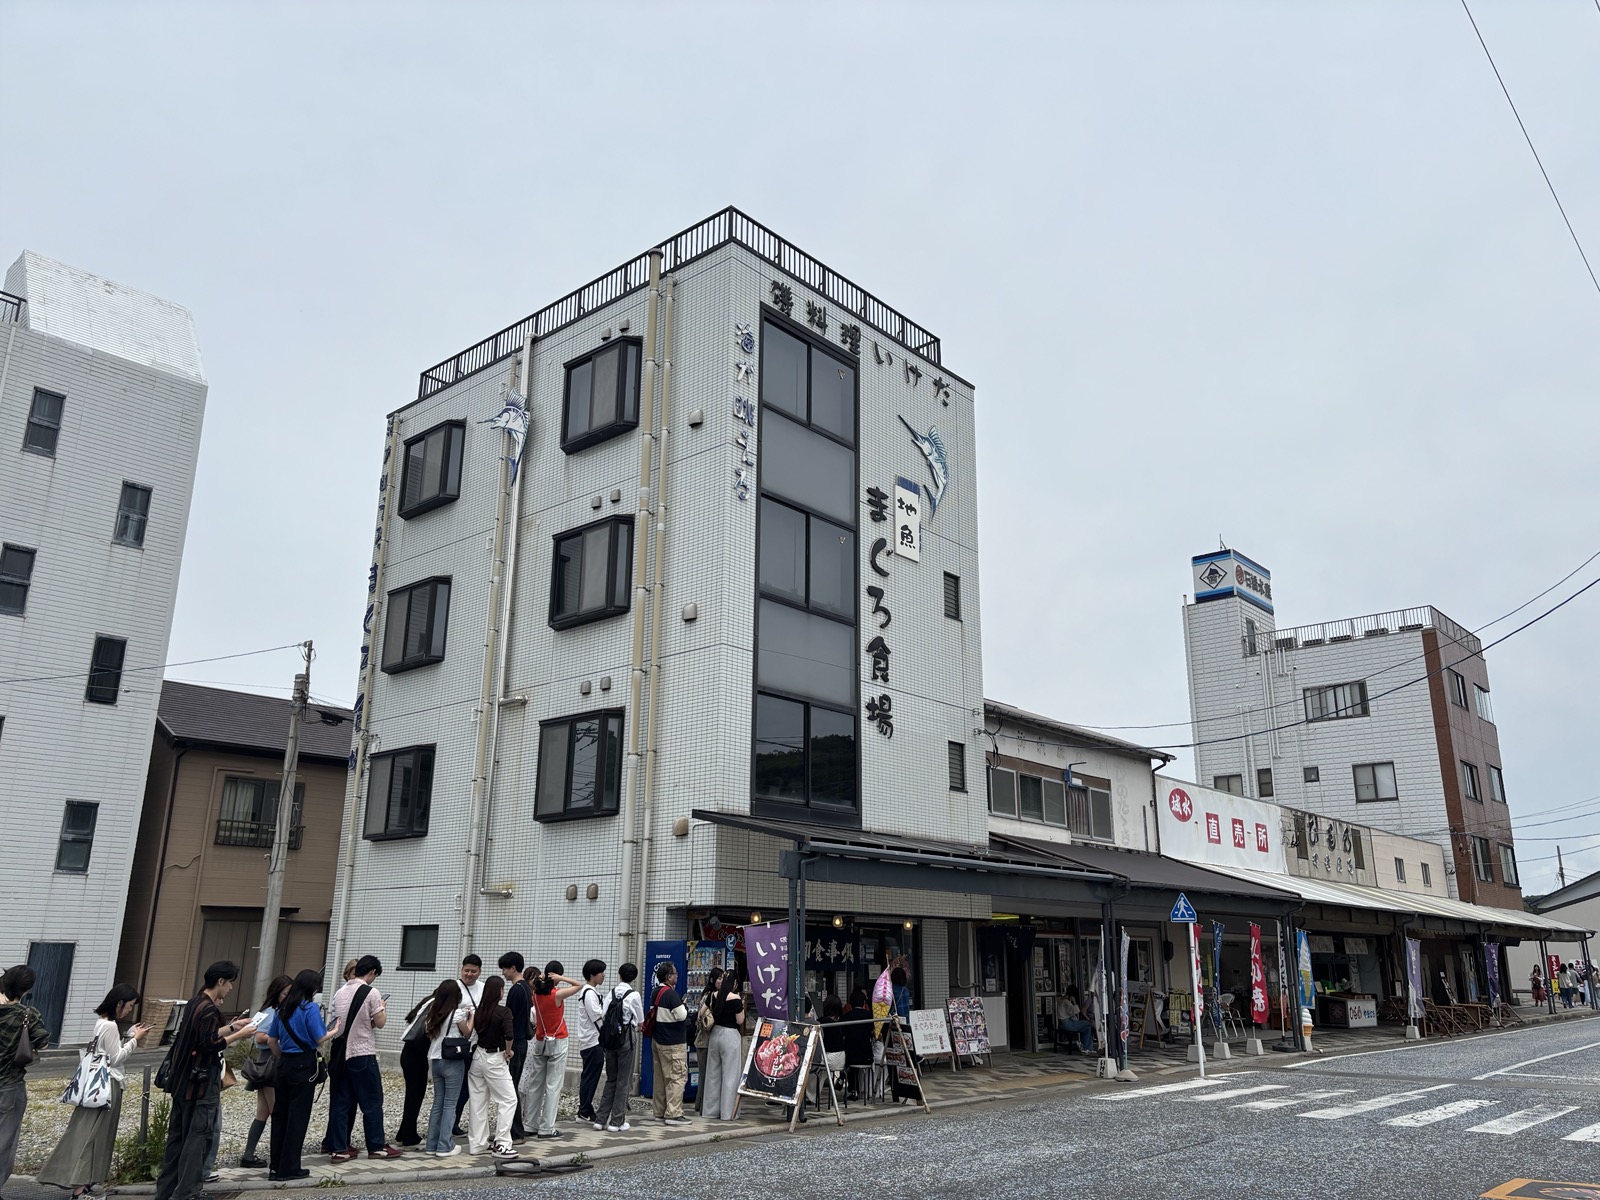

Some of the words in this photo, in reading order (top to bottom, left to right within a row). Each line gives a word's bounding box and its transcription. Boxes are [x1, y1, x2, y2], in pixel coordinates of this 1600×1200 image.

[897, 497, 917, 549] 地魚
[865, 486, 893, 739] まぐろ食場
[1207, 817, 1268, 852] 直売所
[755, 941, 782, 1010] いけだ
